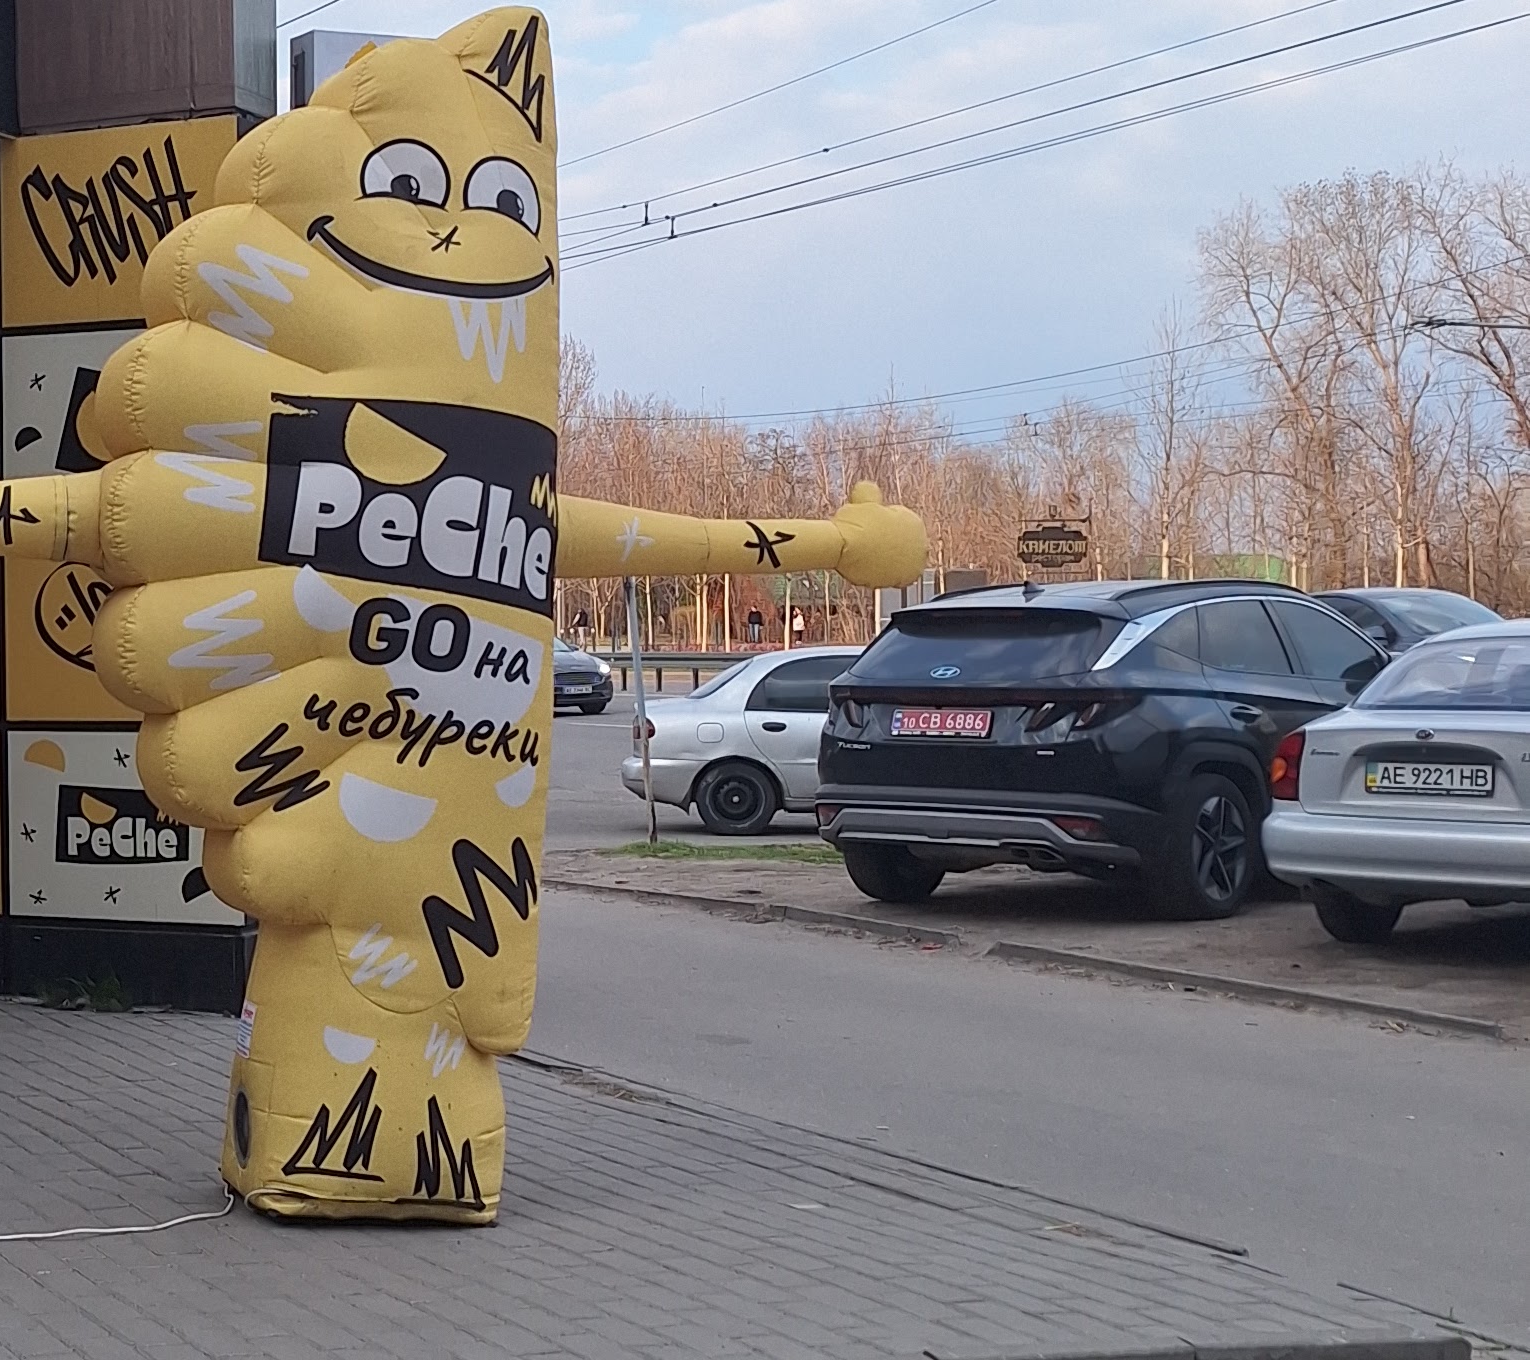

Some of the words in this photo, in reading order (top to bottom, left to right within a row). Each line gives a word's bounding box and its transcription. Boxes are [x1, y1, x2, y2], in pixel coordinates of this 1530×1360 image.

[21, 134, 197, 287] CRUSH
[348, 597, 470, 673] GO
[473, 641, 531, 685] на
[303, 688, 540, 767] чебуреки
[903, 717, 916, 729] 10
[919, 713, 941, 728] CB
[945, 713, 984, 730] 6886
[1380, 766, 1406, 784] AE
[1411, 767, 1454, 786] 9221
[1459, 768, 1488, 787] HB
